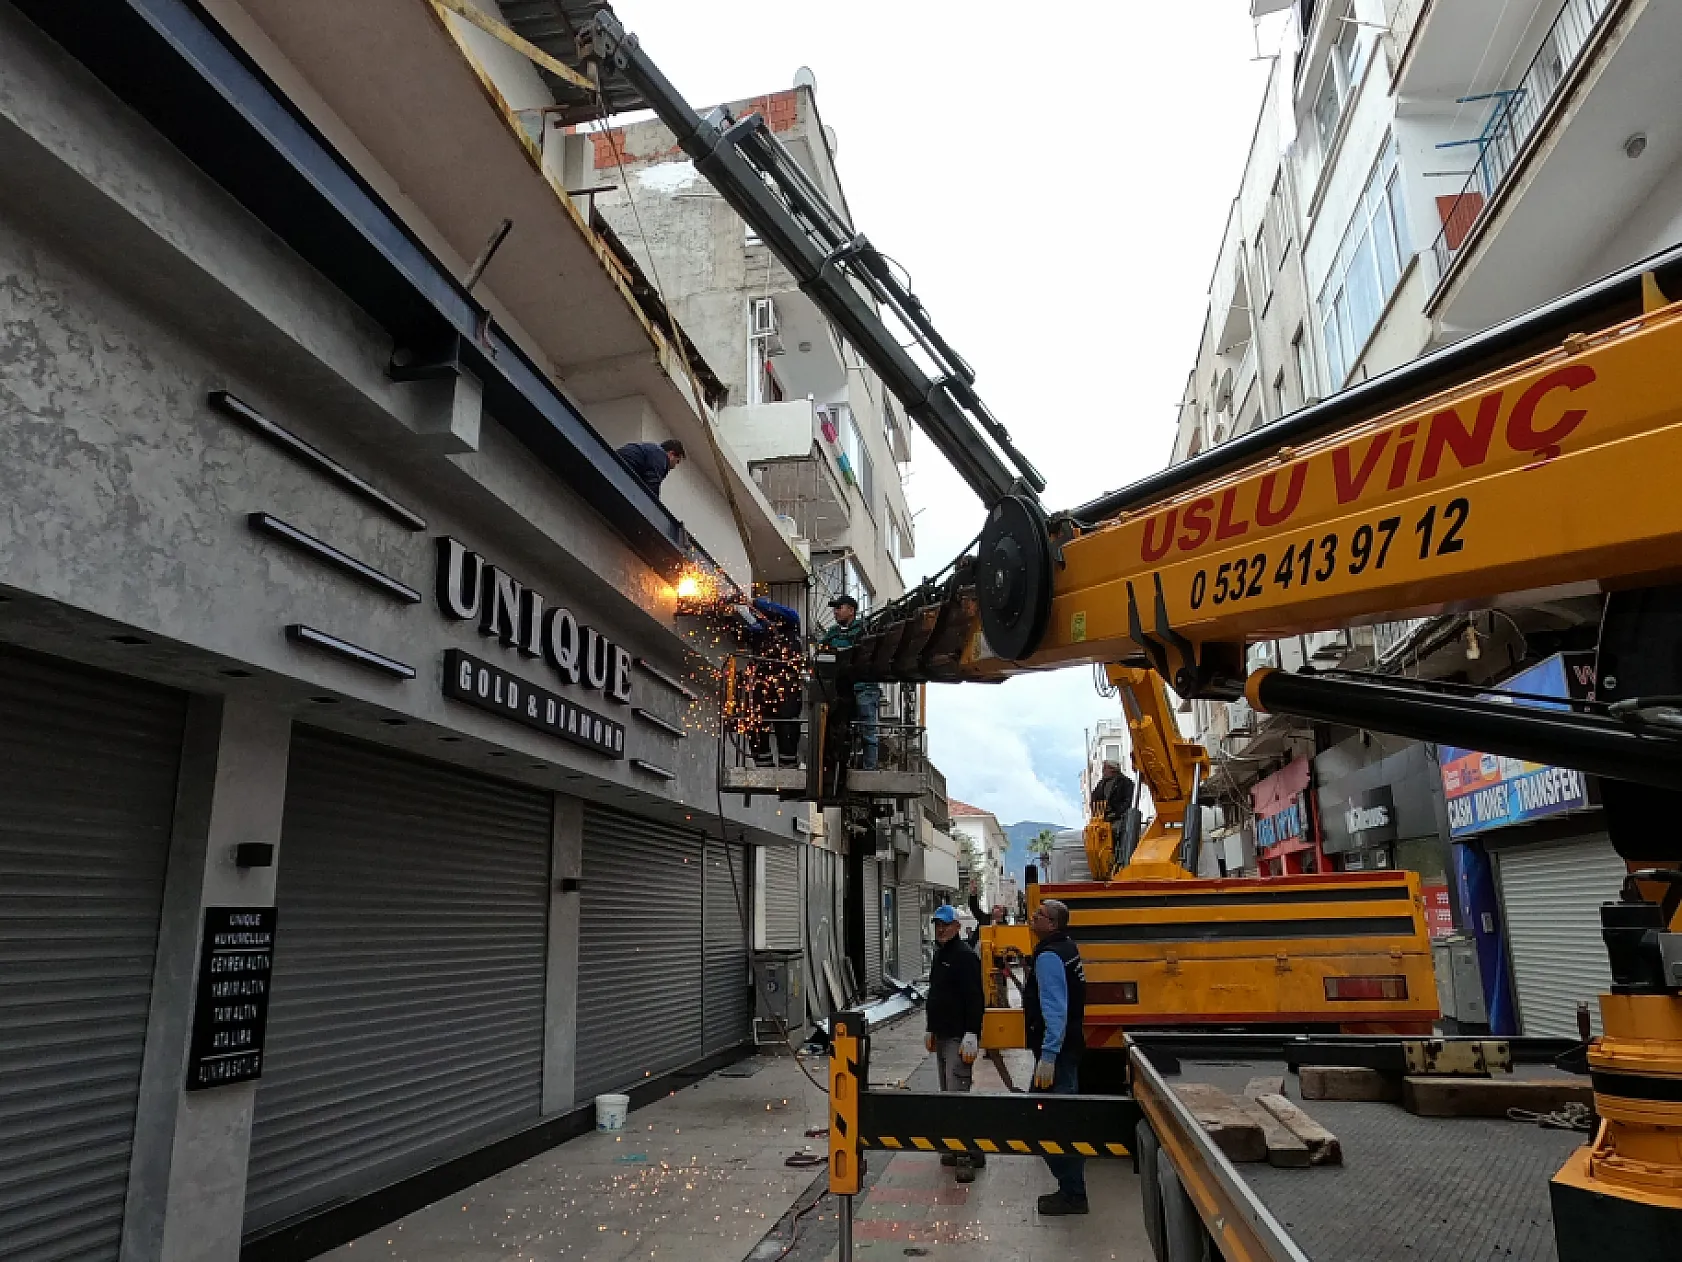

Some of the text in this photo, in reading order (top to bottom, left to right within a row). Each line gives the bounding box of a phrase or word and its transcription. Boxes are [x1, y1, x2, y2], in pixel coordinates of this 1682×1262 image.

[1140, 461, 1308, 562] USLU
[1190, 497, 1469, 609] 0 532 413 97 12
[437, 535, 632, 704] UNIQUE
[460, 659, 623, 752] GOLD & DIAMOND
[1448, 796, 1473, 829] CASH
[1474, 783, 1510, 822] MONEY
[1514, 768, 1582, 812] TRANSFER
